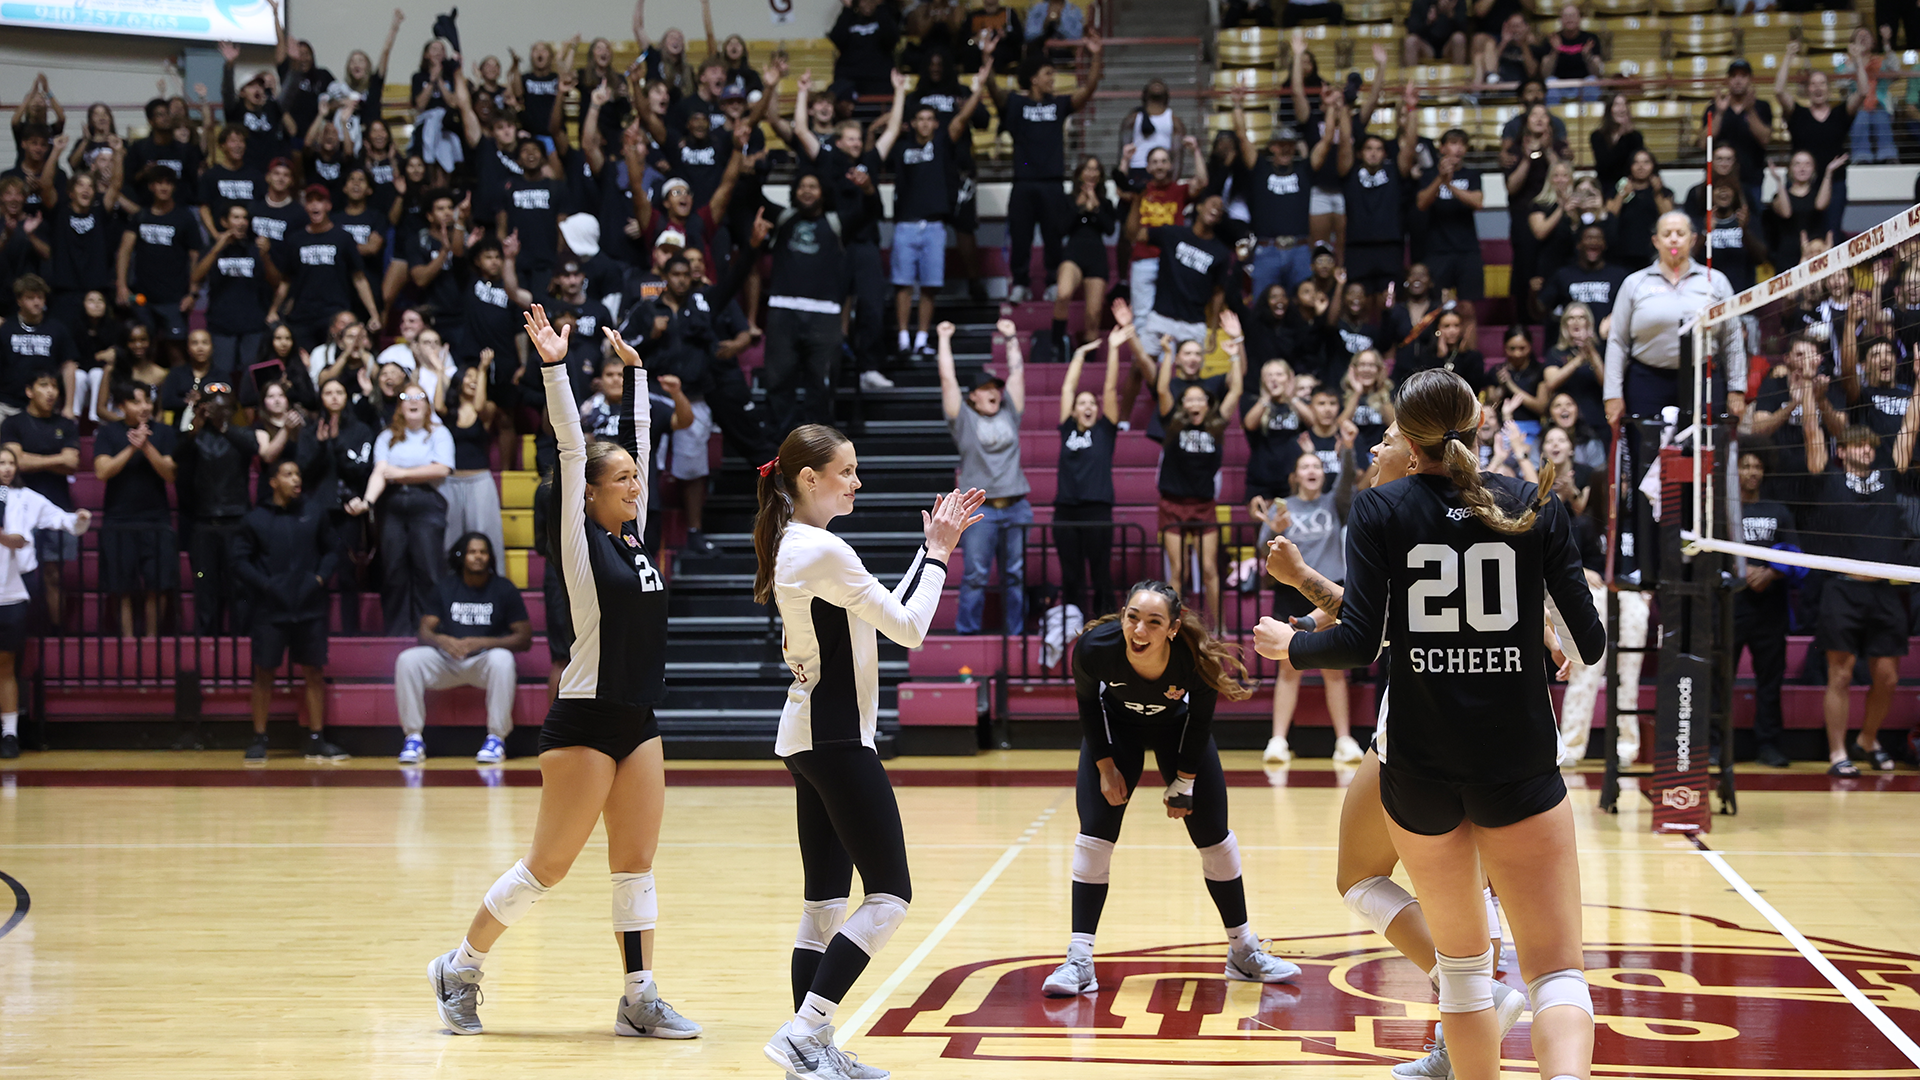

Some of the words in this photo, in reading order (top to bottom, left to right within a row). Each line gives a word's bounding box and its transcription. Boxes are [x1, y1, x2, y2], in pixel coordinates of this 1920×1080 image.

[1407, 542, 1518, 632] 20
[1410, 647, 1522, 673] SCHEER
[1677, 676, 1693, 720] sports
[1675, 720, 1692, 772] imports
